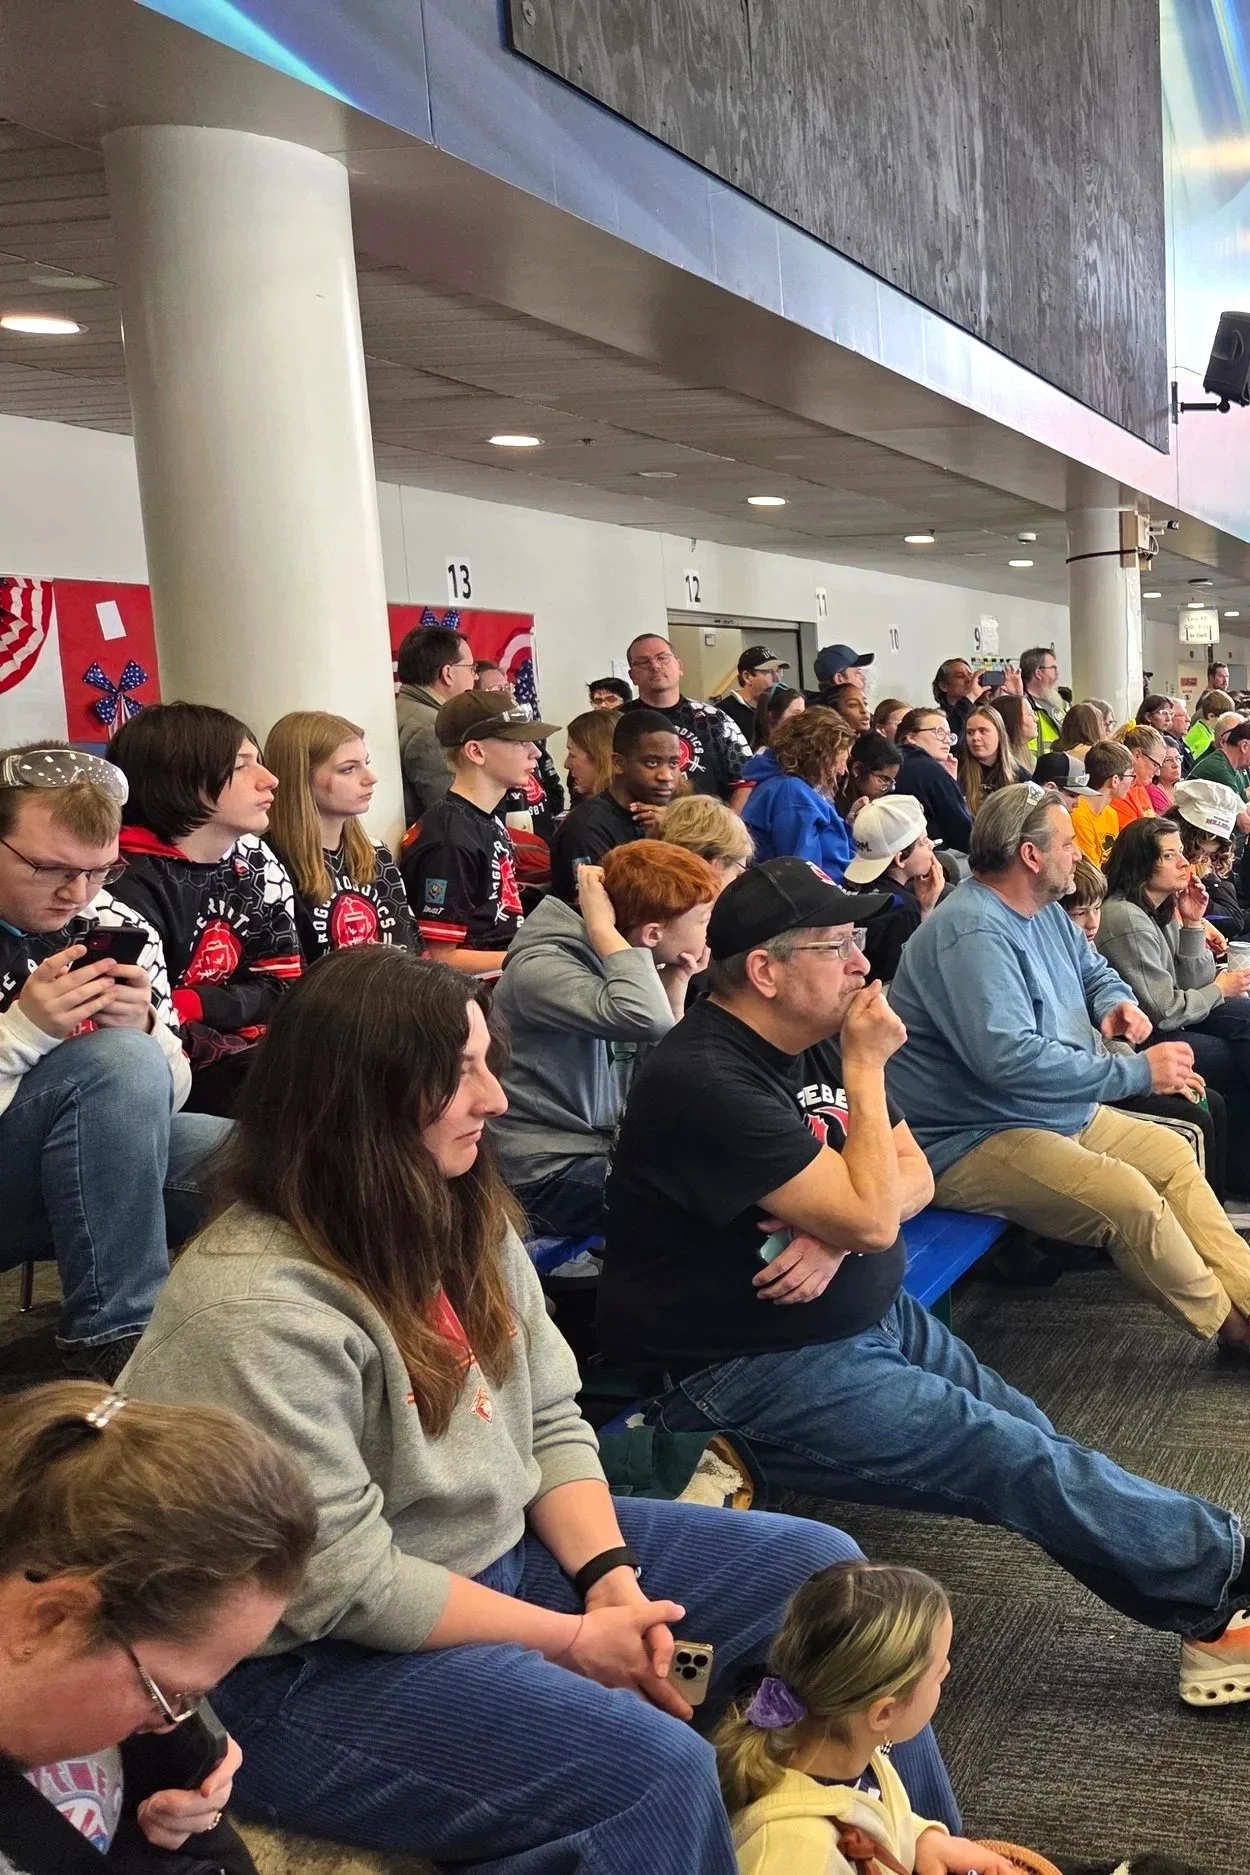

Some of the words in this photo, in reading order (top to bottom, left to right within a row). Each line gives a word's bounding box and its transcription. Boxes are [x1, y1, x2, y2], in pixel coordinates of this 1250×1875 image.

[447, 564, 473, 600] 13
[685, 575, 701, 604] 12
[817, 592, 828, 617] 11
[889, 628, 899, 650] 10
[974, 627, 981, 651] 9
[674, 725, 704, 754] OTICS
[528, 803, 545, 816] 987
